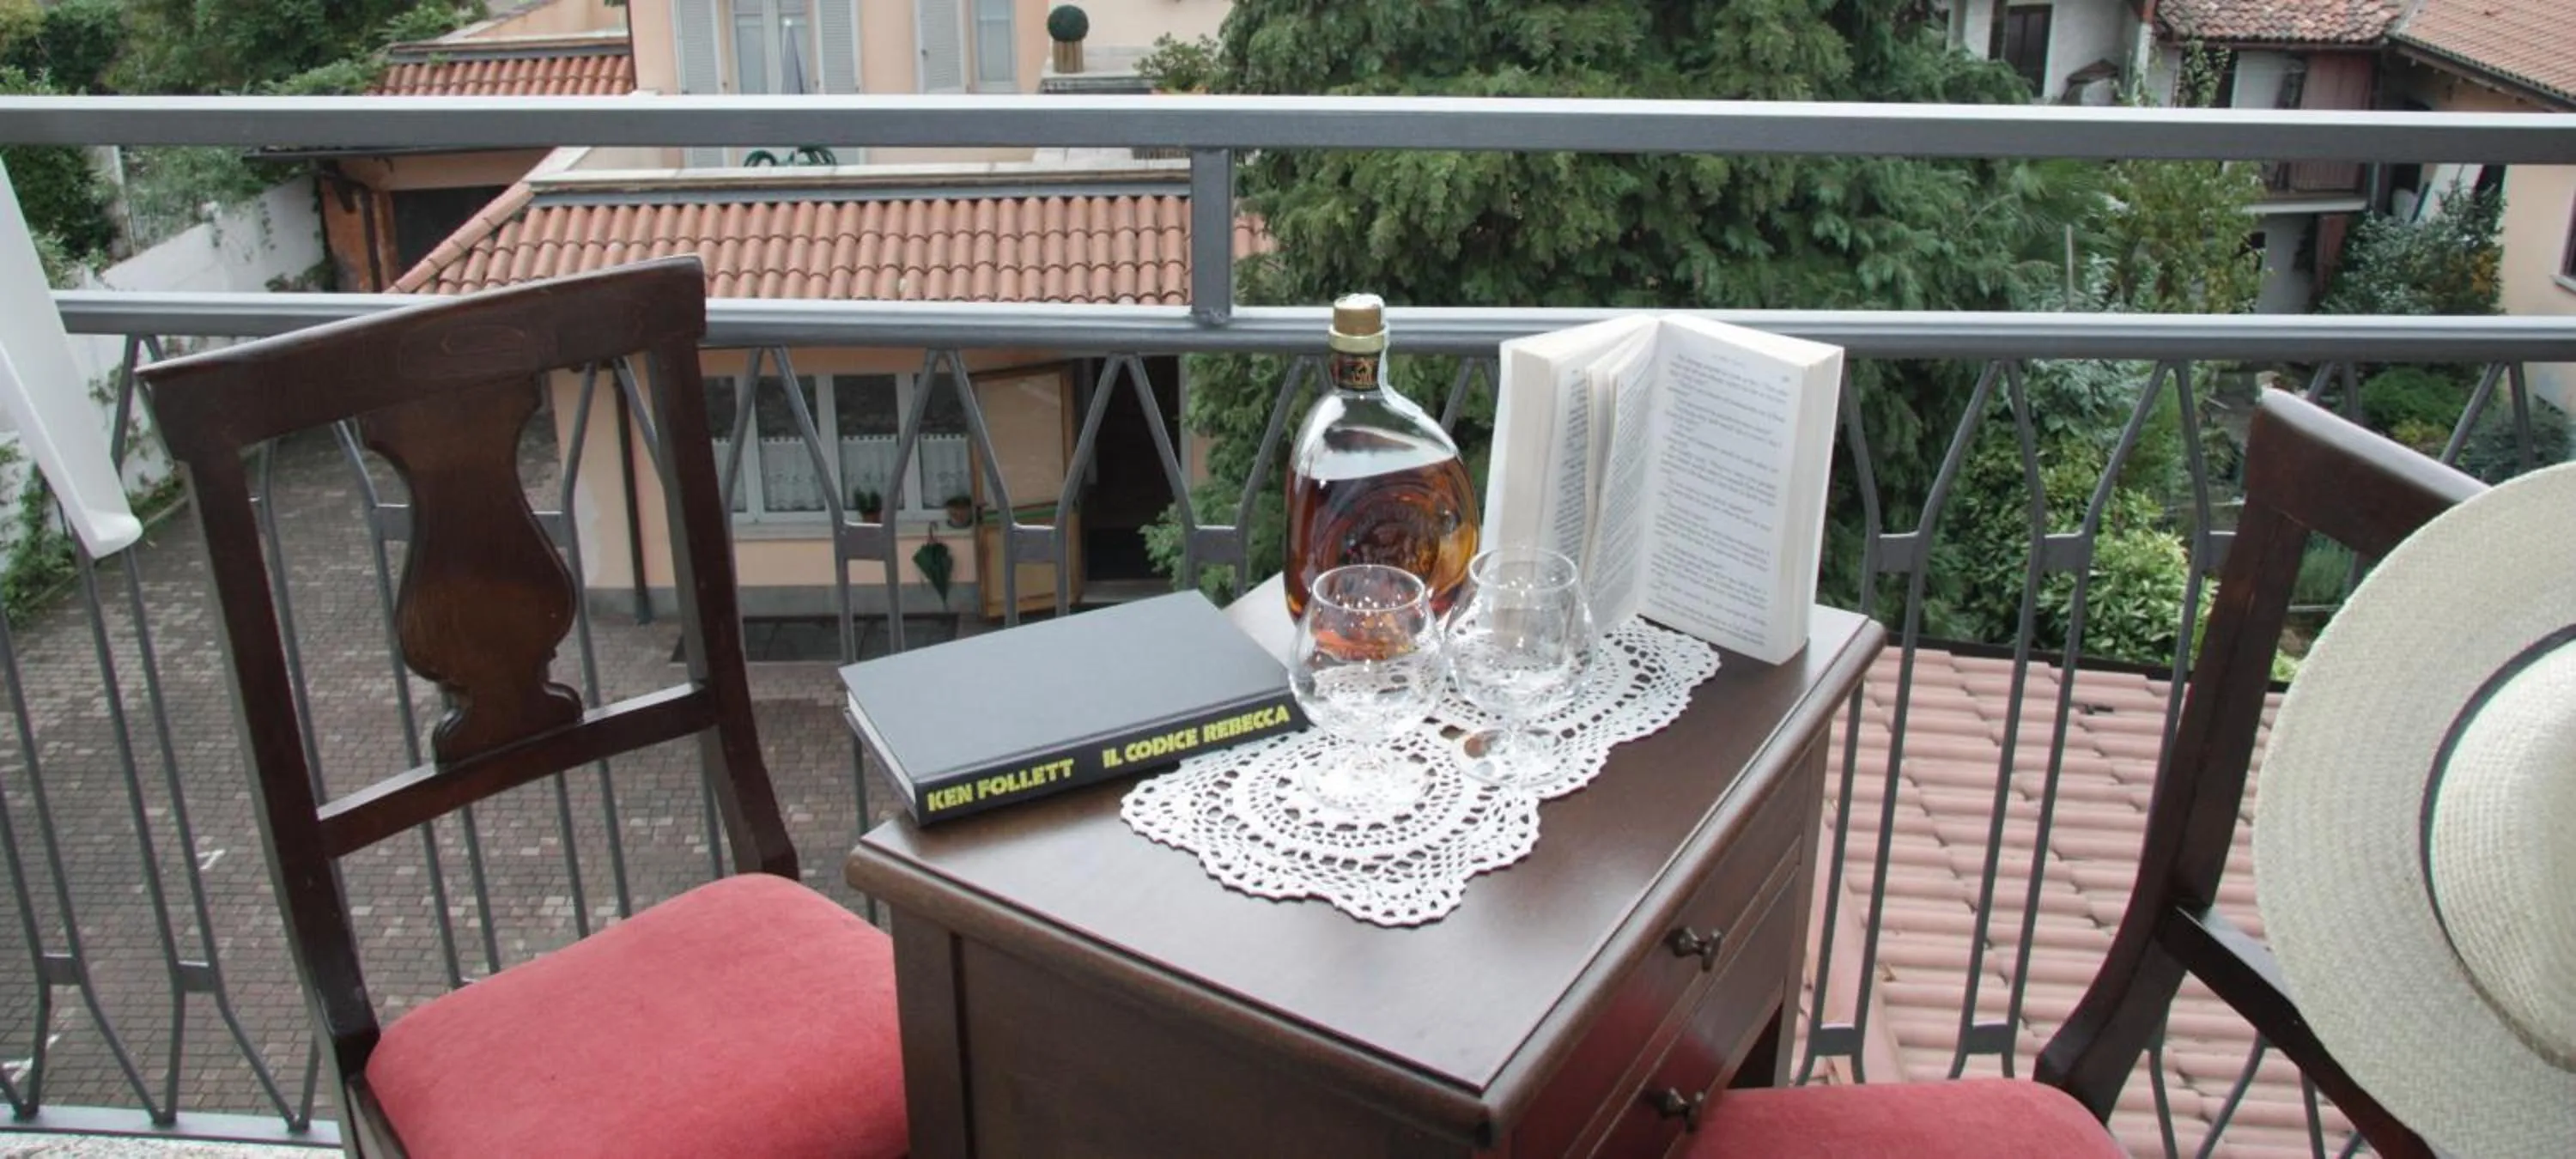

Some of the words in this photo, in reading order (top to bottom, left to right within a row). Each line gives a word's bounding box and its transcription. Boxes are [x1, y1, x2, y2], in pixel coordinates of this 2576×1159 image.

[1103, 748, 1122, 768] IL
[1124, 727, 1199, 762] CODICE
[1202, 705, 1291, 743] REBECCA
[927, 780, 973, 811] KEN
[977, 757, 1074, 798] FOLLETT
